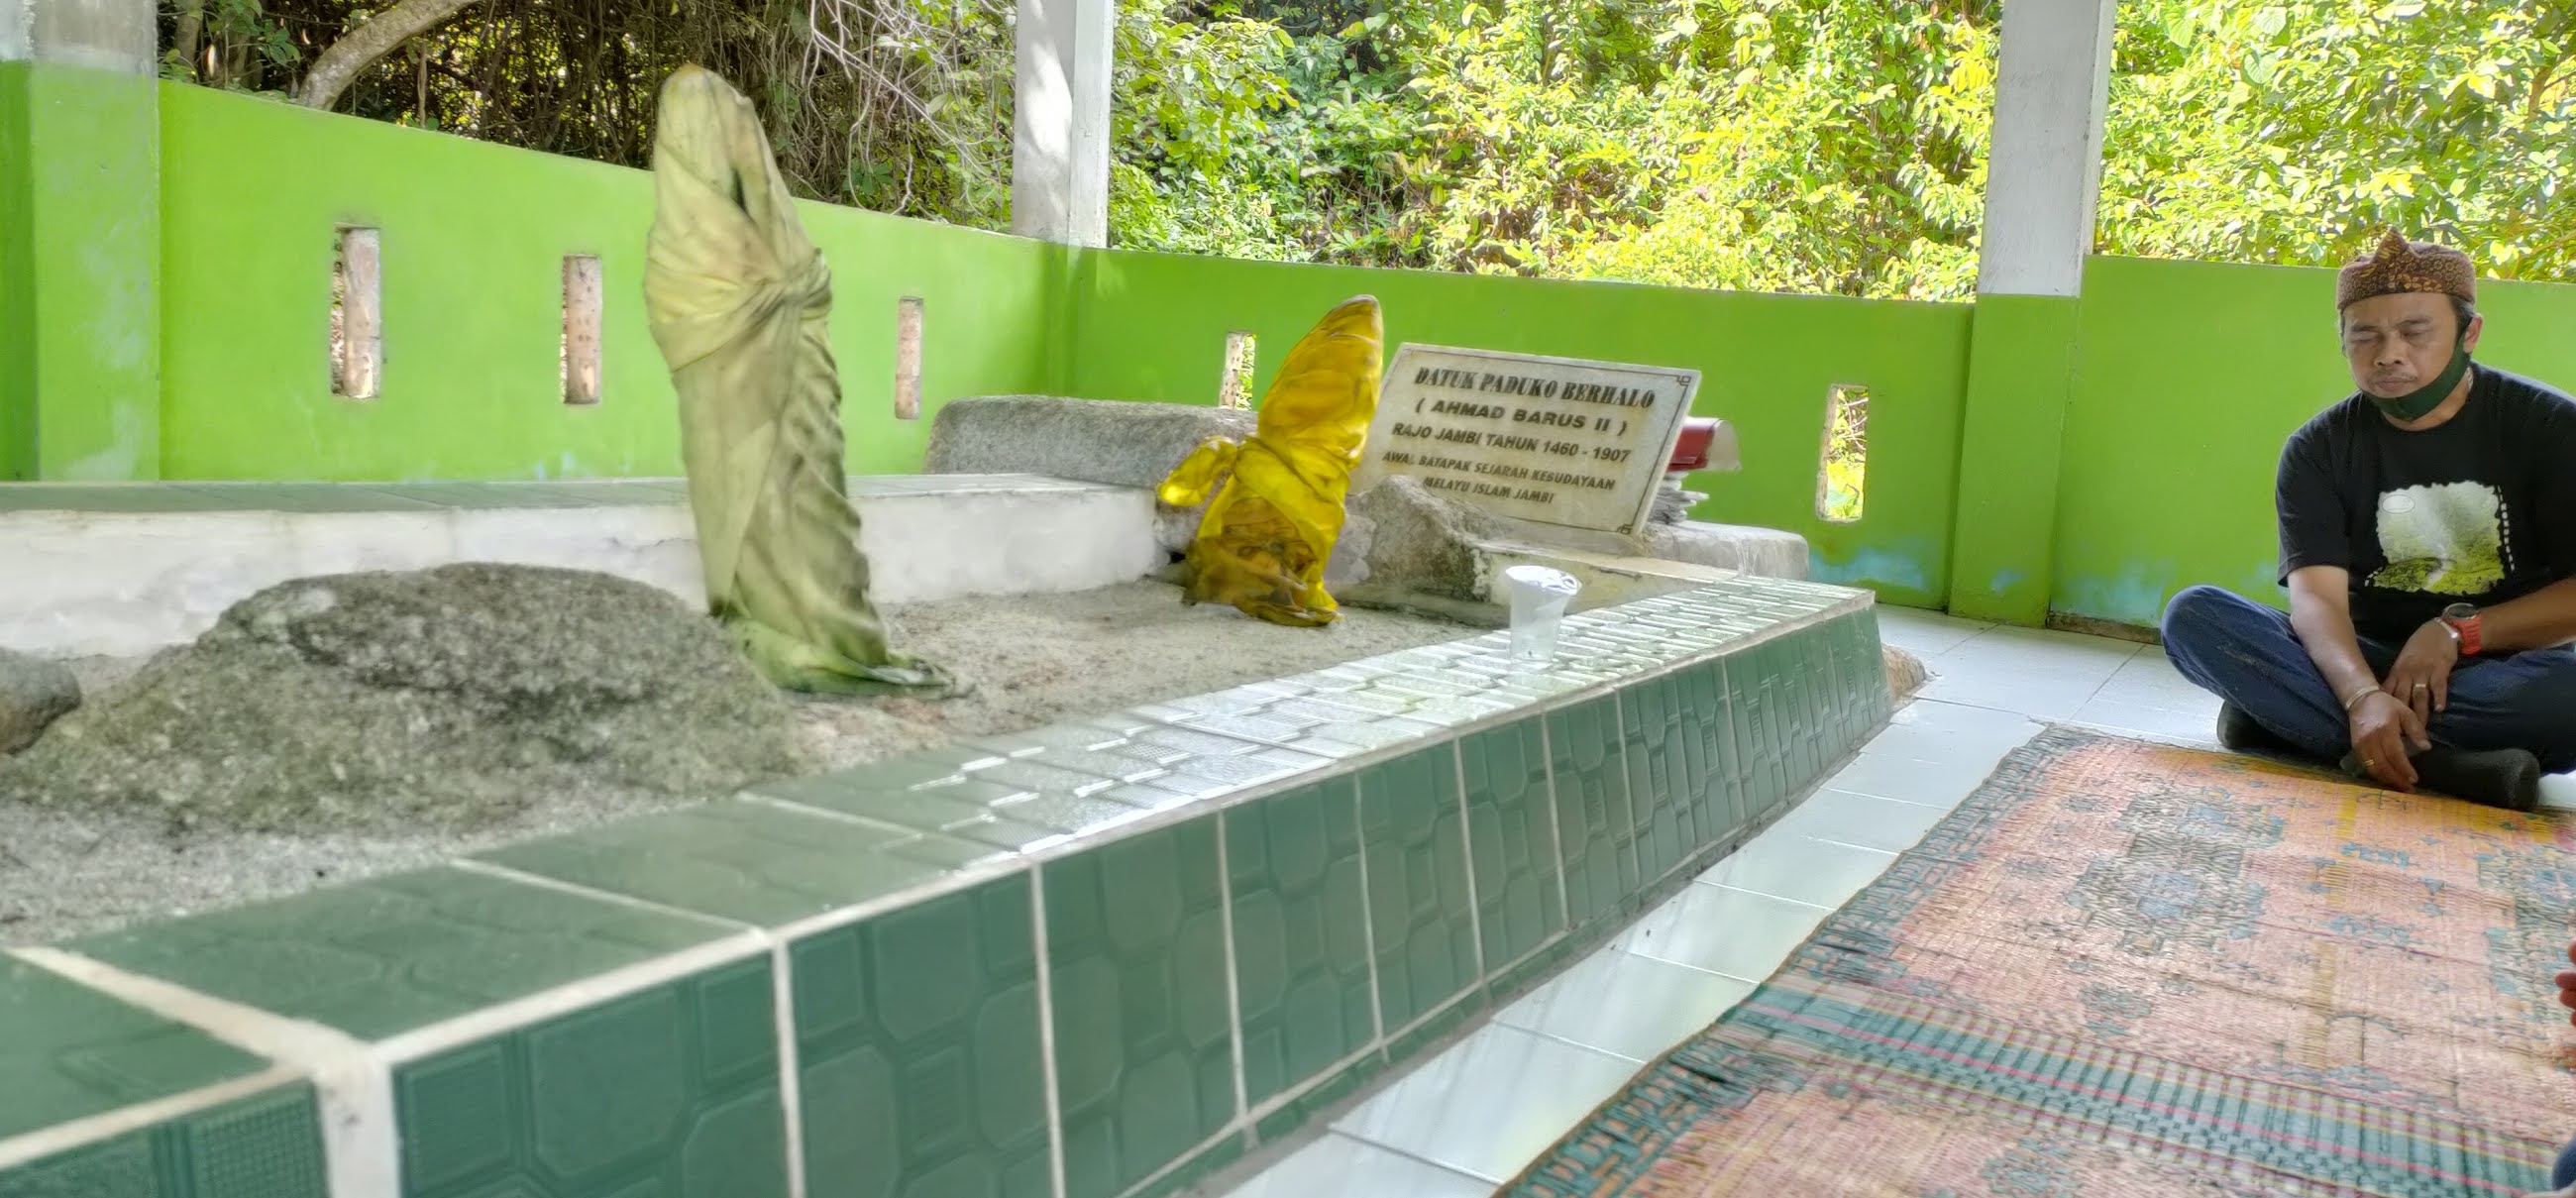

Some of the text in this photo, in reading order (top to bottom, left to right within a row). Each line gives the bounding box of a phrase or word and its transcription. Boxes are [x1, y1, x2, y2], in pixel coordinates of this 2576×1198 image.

[1415, 368, 1655, 408] DATUK PADUKO BERHALO
[1430, 400, 1505, 419] AHMAD
[1512, 408, 1586, 428] BARUS
[1594, 417, 1610, 432] II
[1392, 423, 1432, 438] RAJO
[1434, 428, 1482, 445] JAMBI
[1486, 434, 1539, 452] TAHUN
[1543, 442, 1579, 457] 1460
[1592, 448, 1631, 463] 1907
[1424, 477, 1555, 504] MELAYU ISLAM JAMBI
[1474, 462, 1529, 479] SEJARAH
[1531, 469, 1616, 490] KEBUDAYAAN
